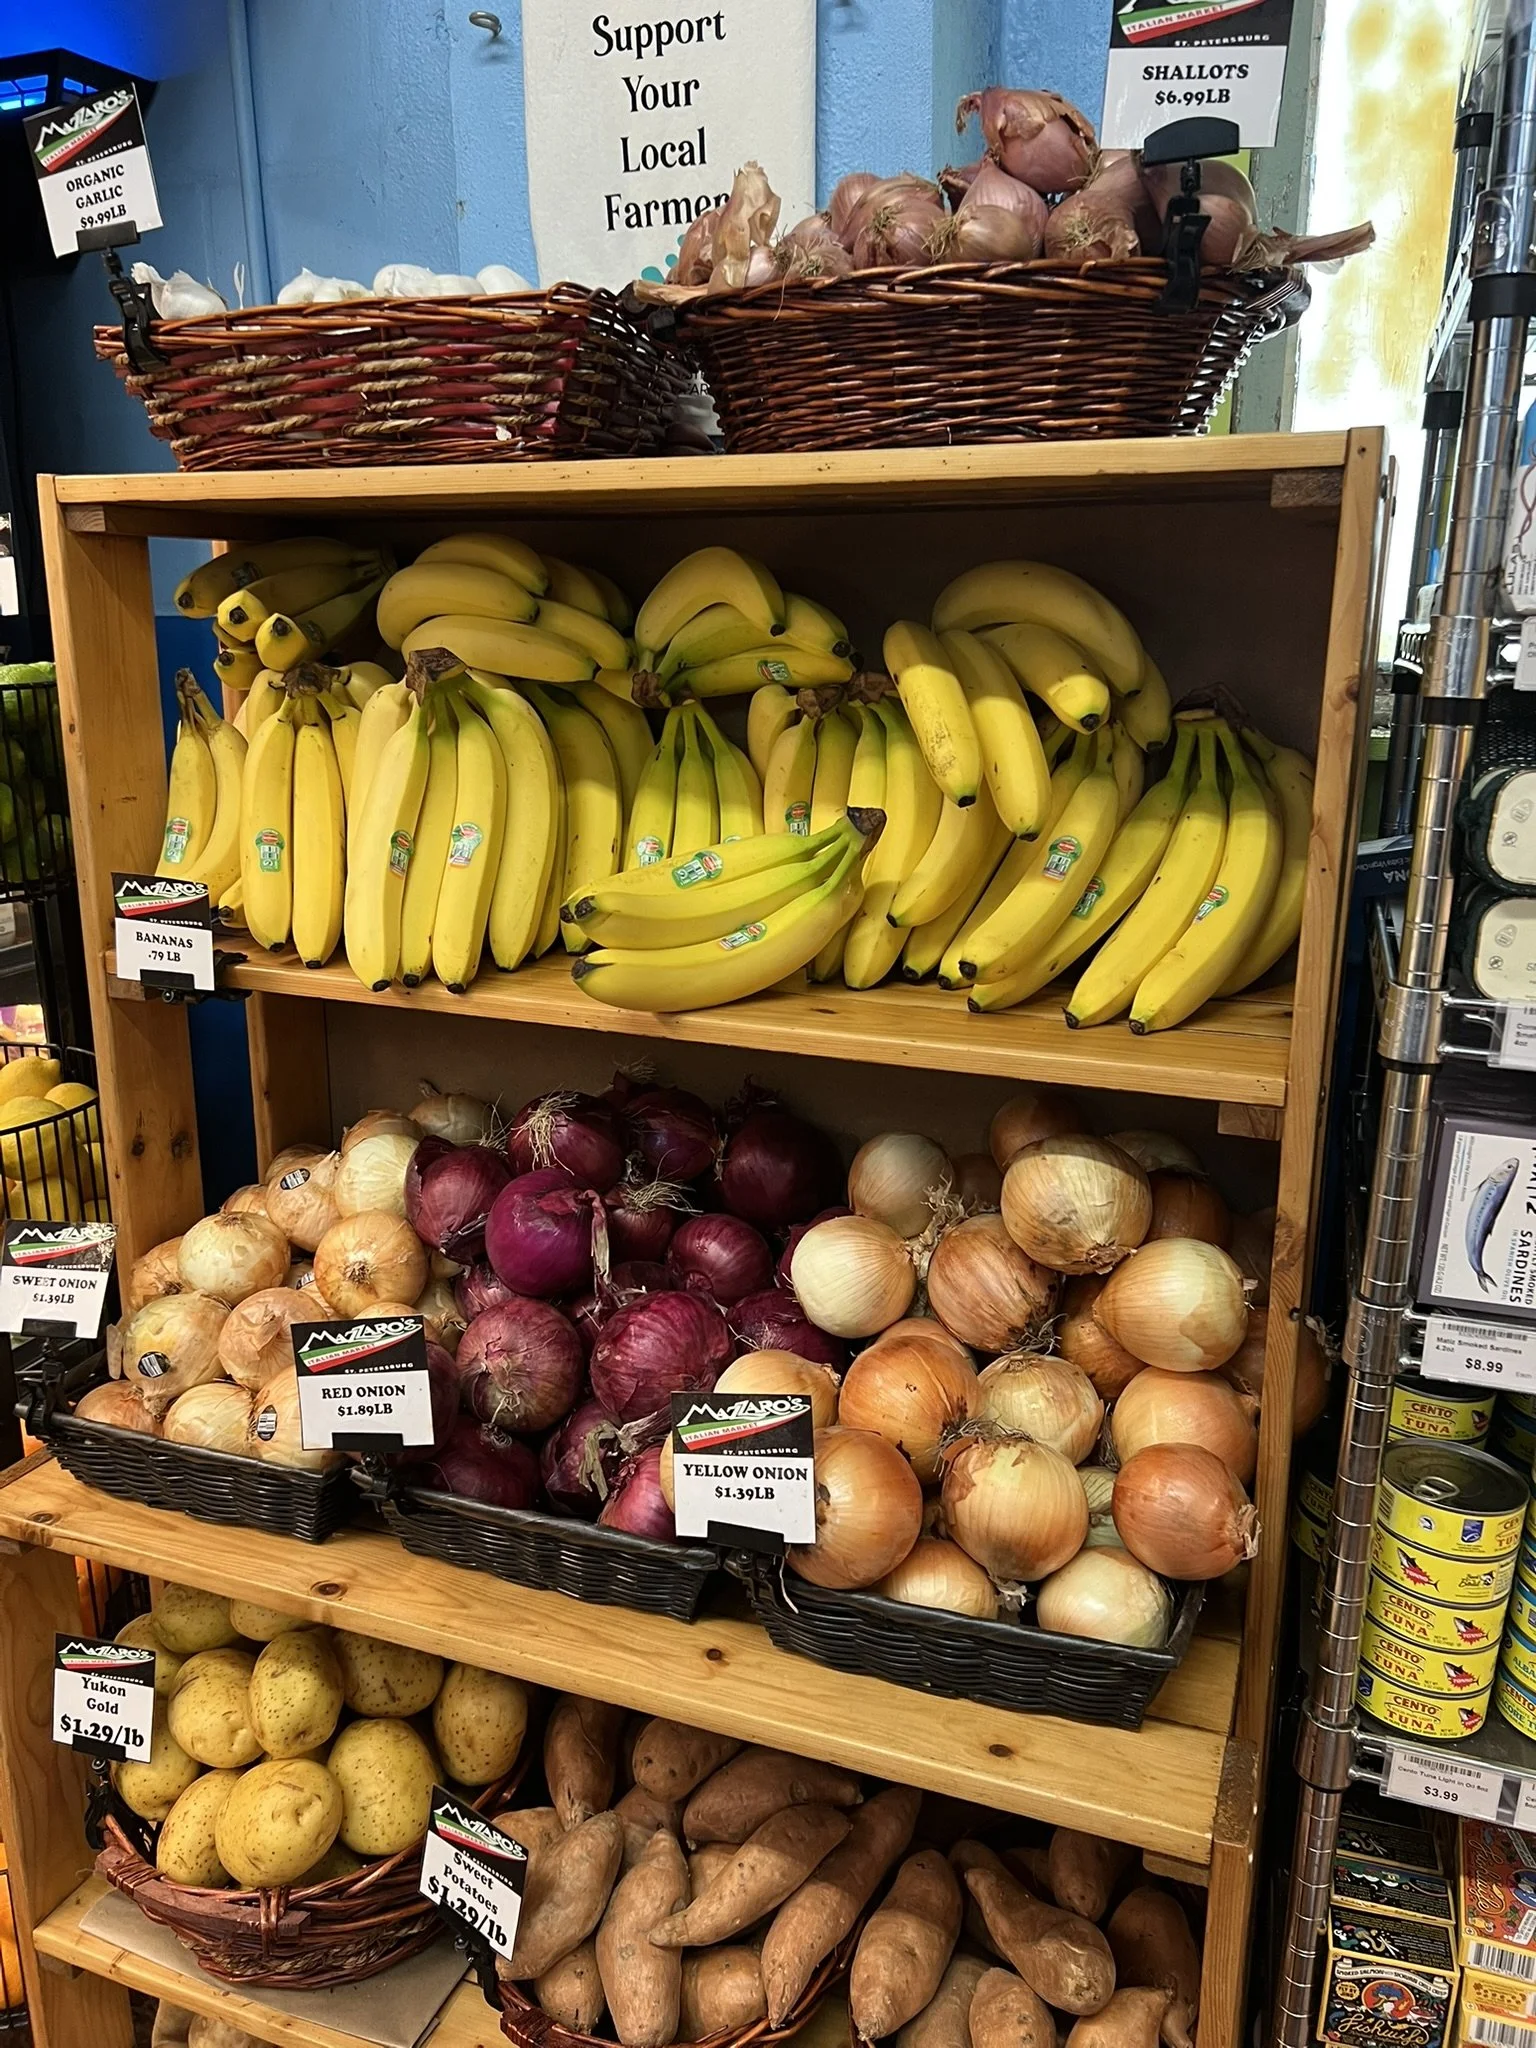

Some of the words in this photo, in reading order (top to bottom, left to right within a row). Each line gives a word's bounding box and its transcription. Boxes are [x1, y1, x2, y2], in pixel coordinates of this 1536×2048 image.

[1126, 16, 1174, 32] ITALIAN
[1175, 5, 1224, 20] MARKET
[592, 10, 726, 60] Support
[1194, 34, 1270, 47] PETERSBURG
[1142, 64, 1249, 81] SHALLOTS
[622, 75, 700, 112] Your
[1155, 89, 1231, 106] $6.99LB
[620, 126, 708, 173] Local
[66, 164, 124, 192] ORGANIC
[75, 185, 123, 209] GARLIC
[80, 204, 127, 229] $9.99LB
[136, 931, 193, 949] BANANAS
[148, 950, 164, 960] .79
[167, 951, 181, 962] LB
[1509, 1230, 1533, 1303] SARDINES
[12, 1275, 56, 1287] SWEET
[58, 1278, 98, 1289] ONION
[33, 1293, 75, 1304] $1.39LB
[307, 1353, 340, 1365] ITALIAN
[342, 1343, 376, 1356] MARKET
[359, 1362, 414, 1373] PETERSBURG
[1465, 1358, 1503, 1373] $8.99
[321, 1387, 353, 1399] RED
[356, 1385, 406, 1397] ONION
[338, 1403, 393, 1417] $1.89LB
[1411, 1403, 1453, 1418] CENTO
[685, 1430, 720, 1441] ITALIAN
[722, 1422, 759, 1434] MARKET
[1404, 1416, 1451, 1434] TUNA
[683, 1464, 749, 1479] YELLOW
[752, 1466, 808, 1481] ONION
[715, 1486, 775, 1501] $1.39LB
[1388, 1594, 1430, 1620] CENTO
[1382, 1607, 1428, 1636] TUNA
[1379, 1638, 1420, 1664] CENTO
[1373, 1652, 1419, 1681] TUNA
[81, 1676, 126, 1697] Yukon
[86, 1698, 119, 1715] Gold
[1393, 1695, 1438, 1715] CENTO
[1506, 1683, 1536, 1712] CENTO
[60, 1713, 145, 1747] $1.29/lb
[1386, 1709, 1435, 1731] TUNA
[1420, 1771, 1437, 1780] Tuna
[1438, 1775, 1456, 1785] Light
[1423, 1786, 1459, 1802] $3.99
[453, 1851, 495, 1890] Sweet
[443, 1864, 499, 1916] Potatoes
[428, 1875, 508, 1947] $1.29/lb
